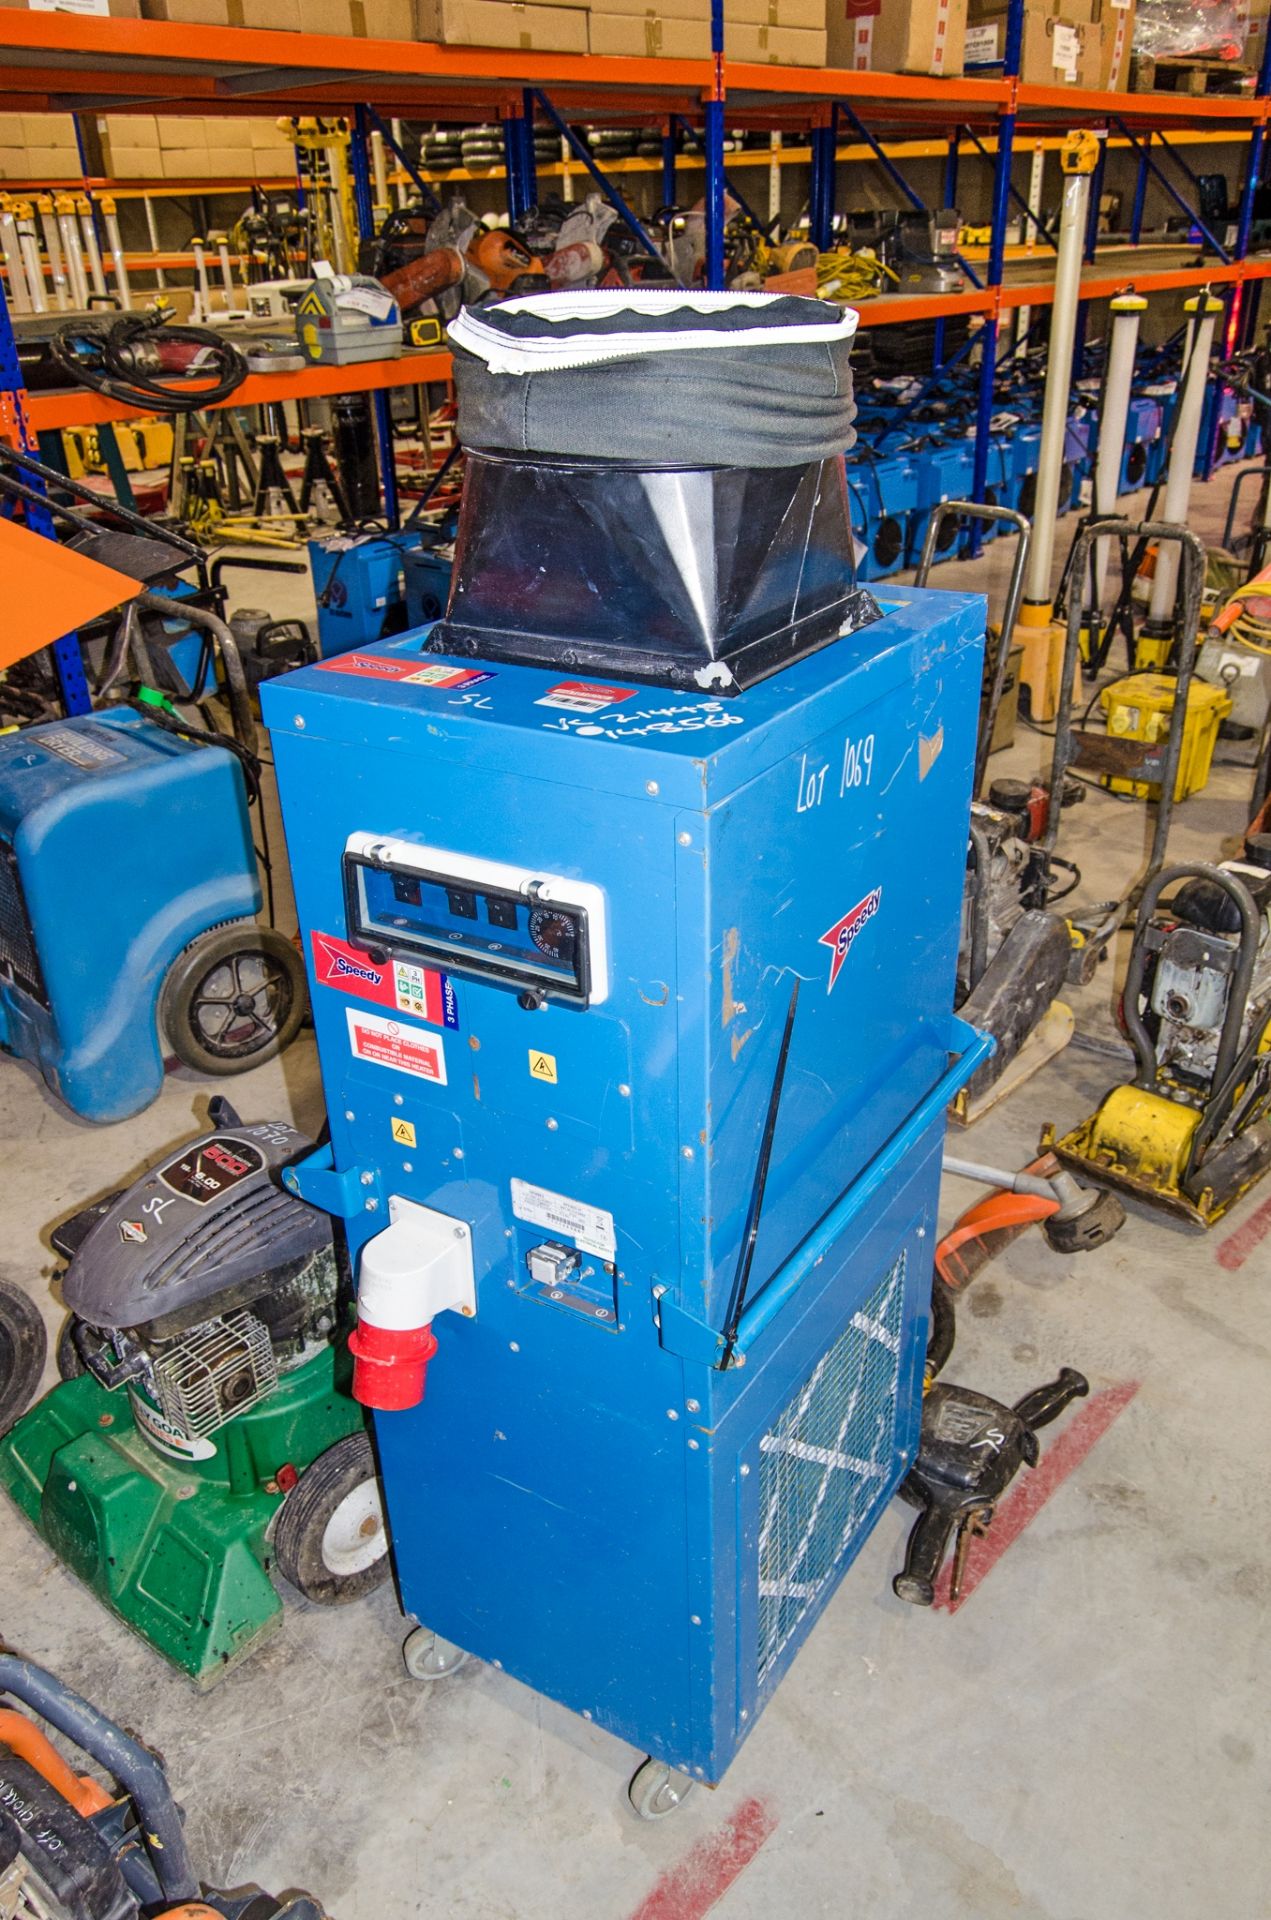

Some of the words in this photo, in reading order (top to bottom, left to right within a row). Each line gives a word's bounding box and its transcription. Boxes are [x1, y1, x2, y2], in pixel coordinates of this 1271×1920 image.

[797, 753, 830, 813] LOT
[839, 734, 875, 798] 1069
[837, 889, 882, 954] Speedy
[337, 958, 382, 985] Speedy
[444, 980, 455, 1015] PHASE
[447, 1015, 455, 1023] 3
[246, 1126, 288, 1144] 1070
